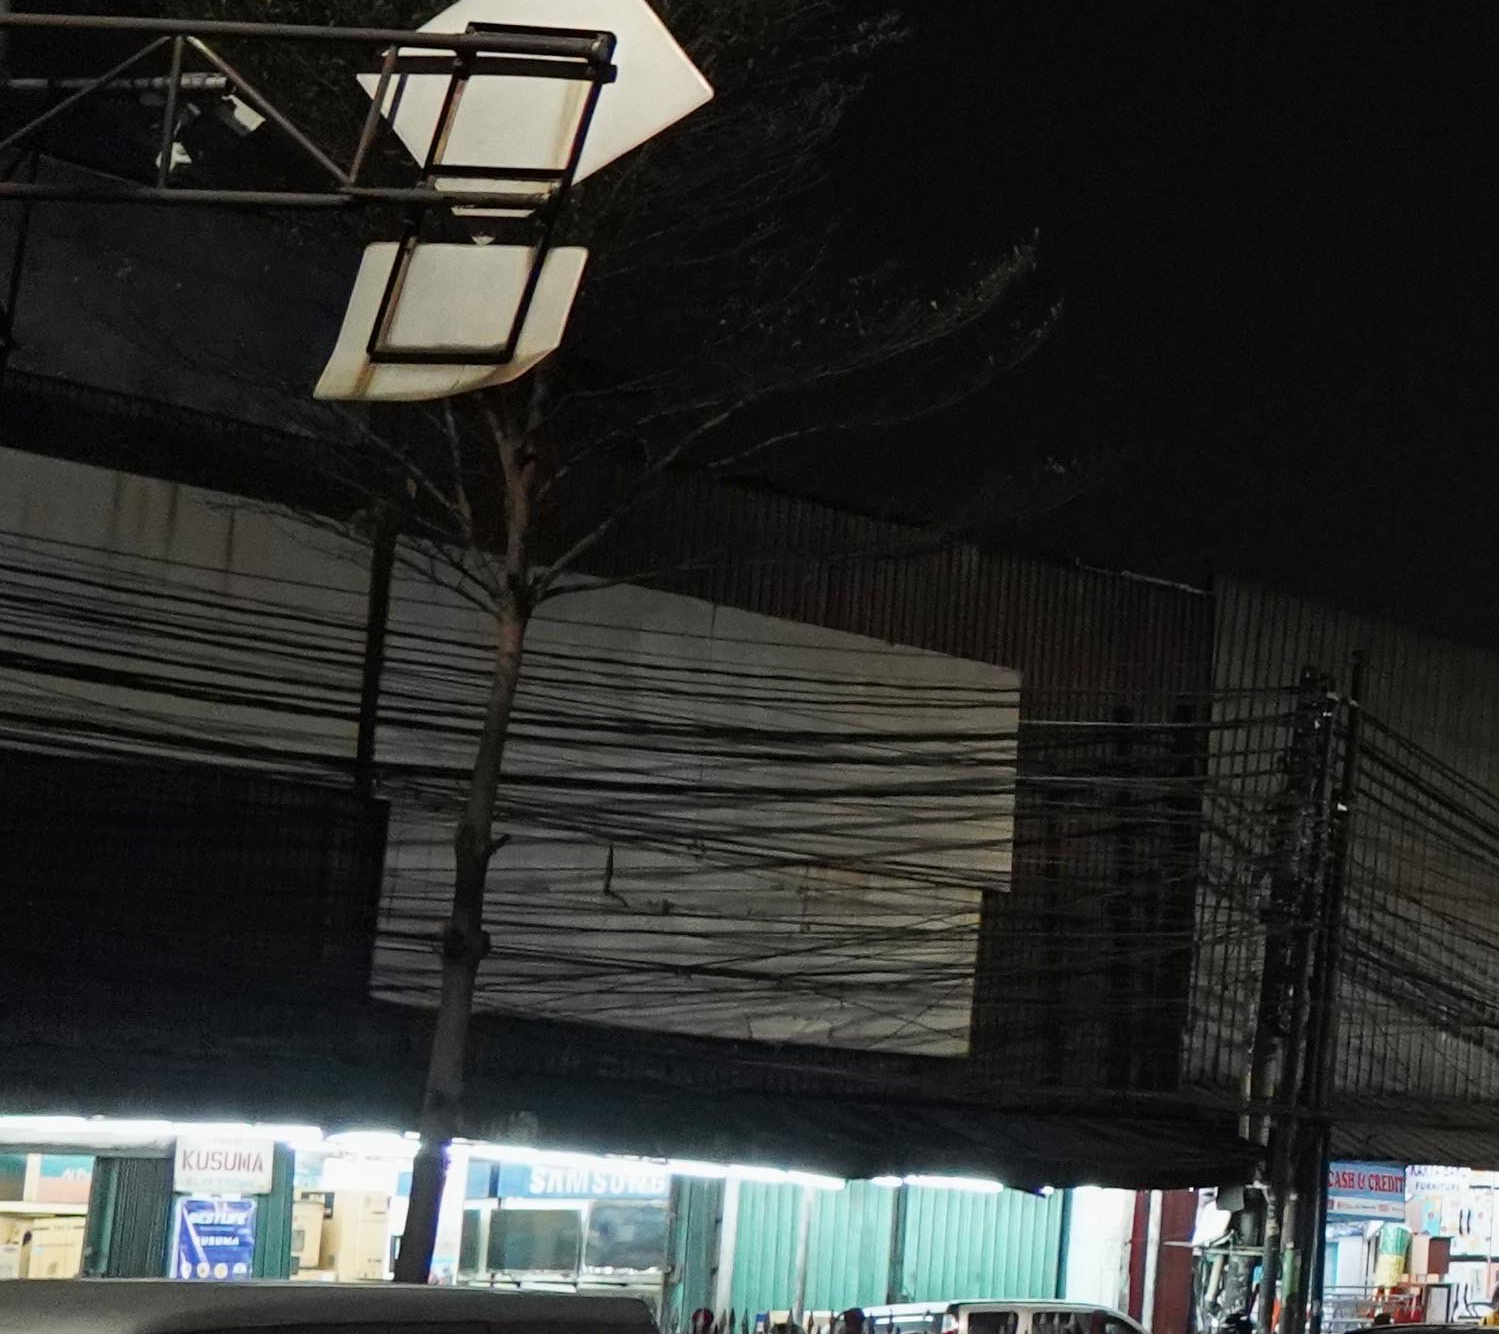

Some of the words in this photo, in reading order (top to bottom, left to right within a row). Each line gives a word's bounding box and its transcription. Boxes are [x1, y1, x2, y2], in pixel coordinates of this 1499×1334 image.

[181, 1150, 264, 1172] KUSUMA
[1328, 1170, 1355, 1189] CASH
[1368, 1173, 1404, 1194] CREDIT
